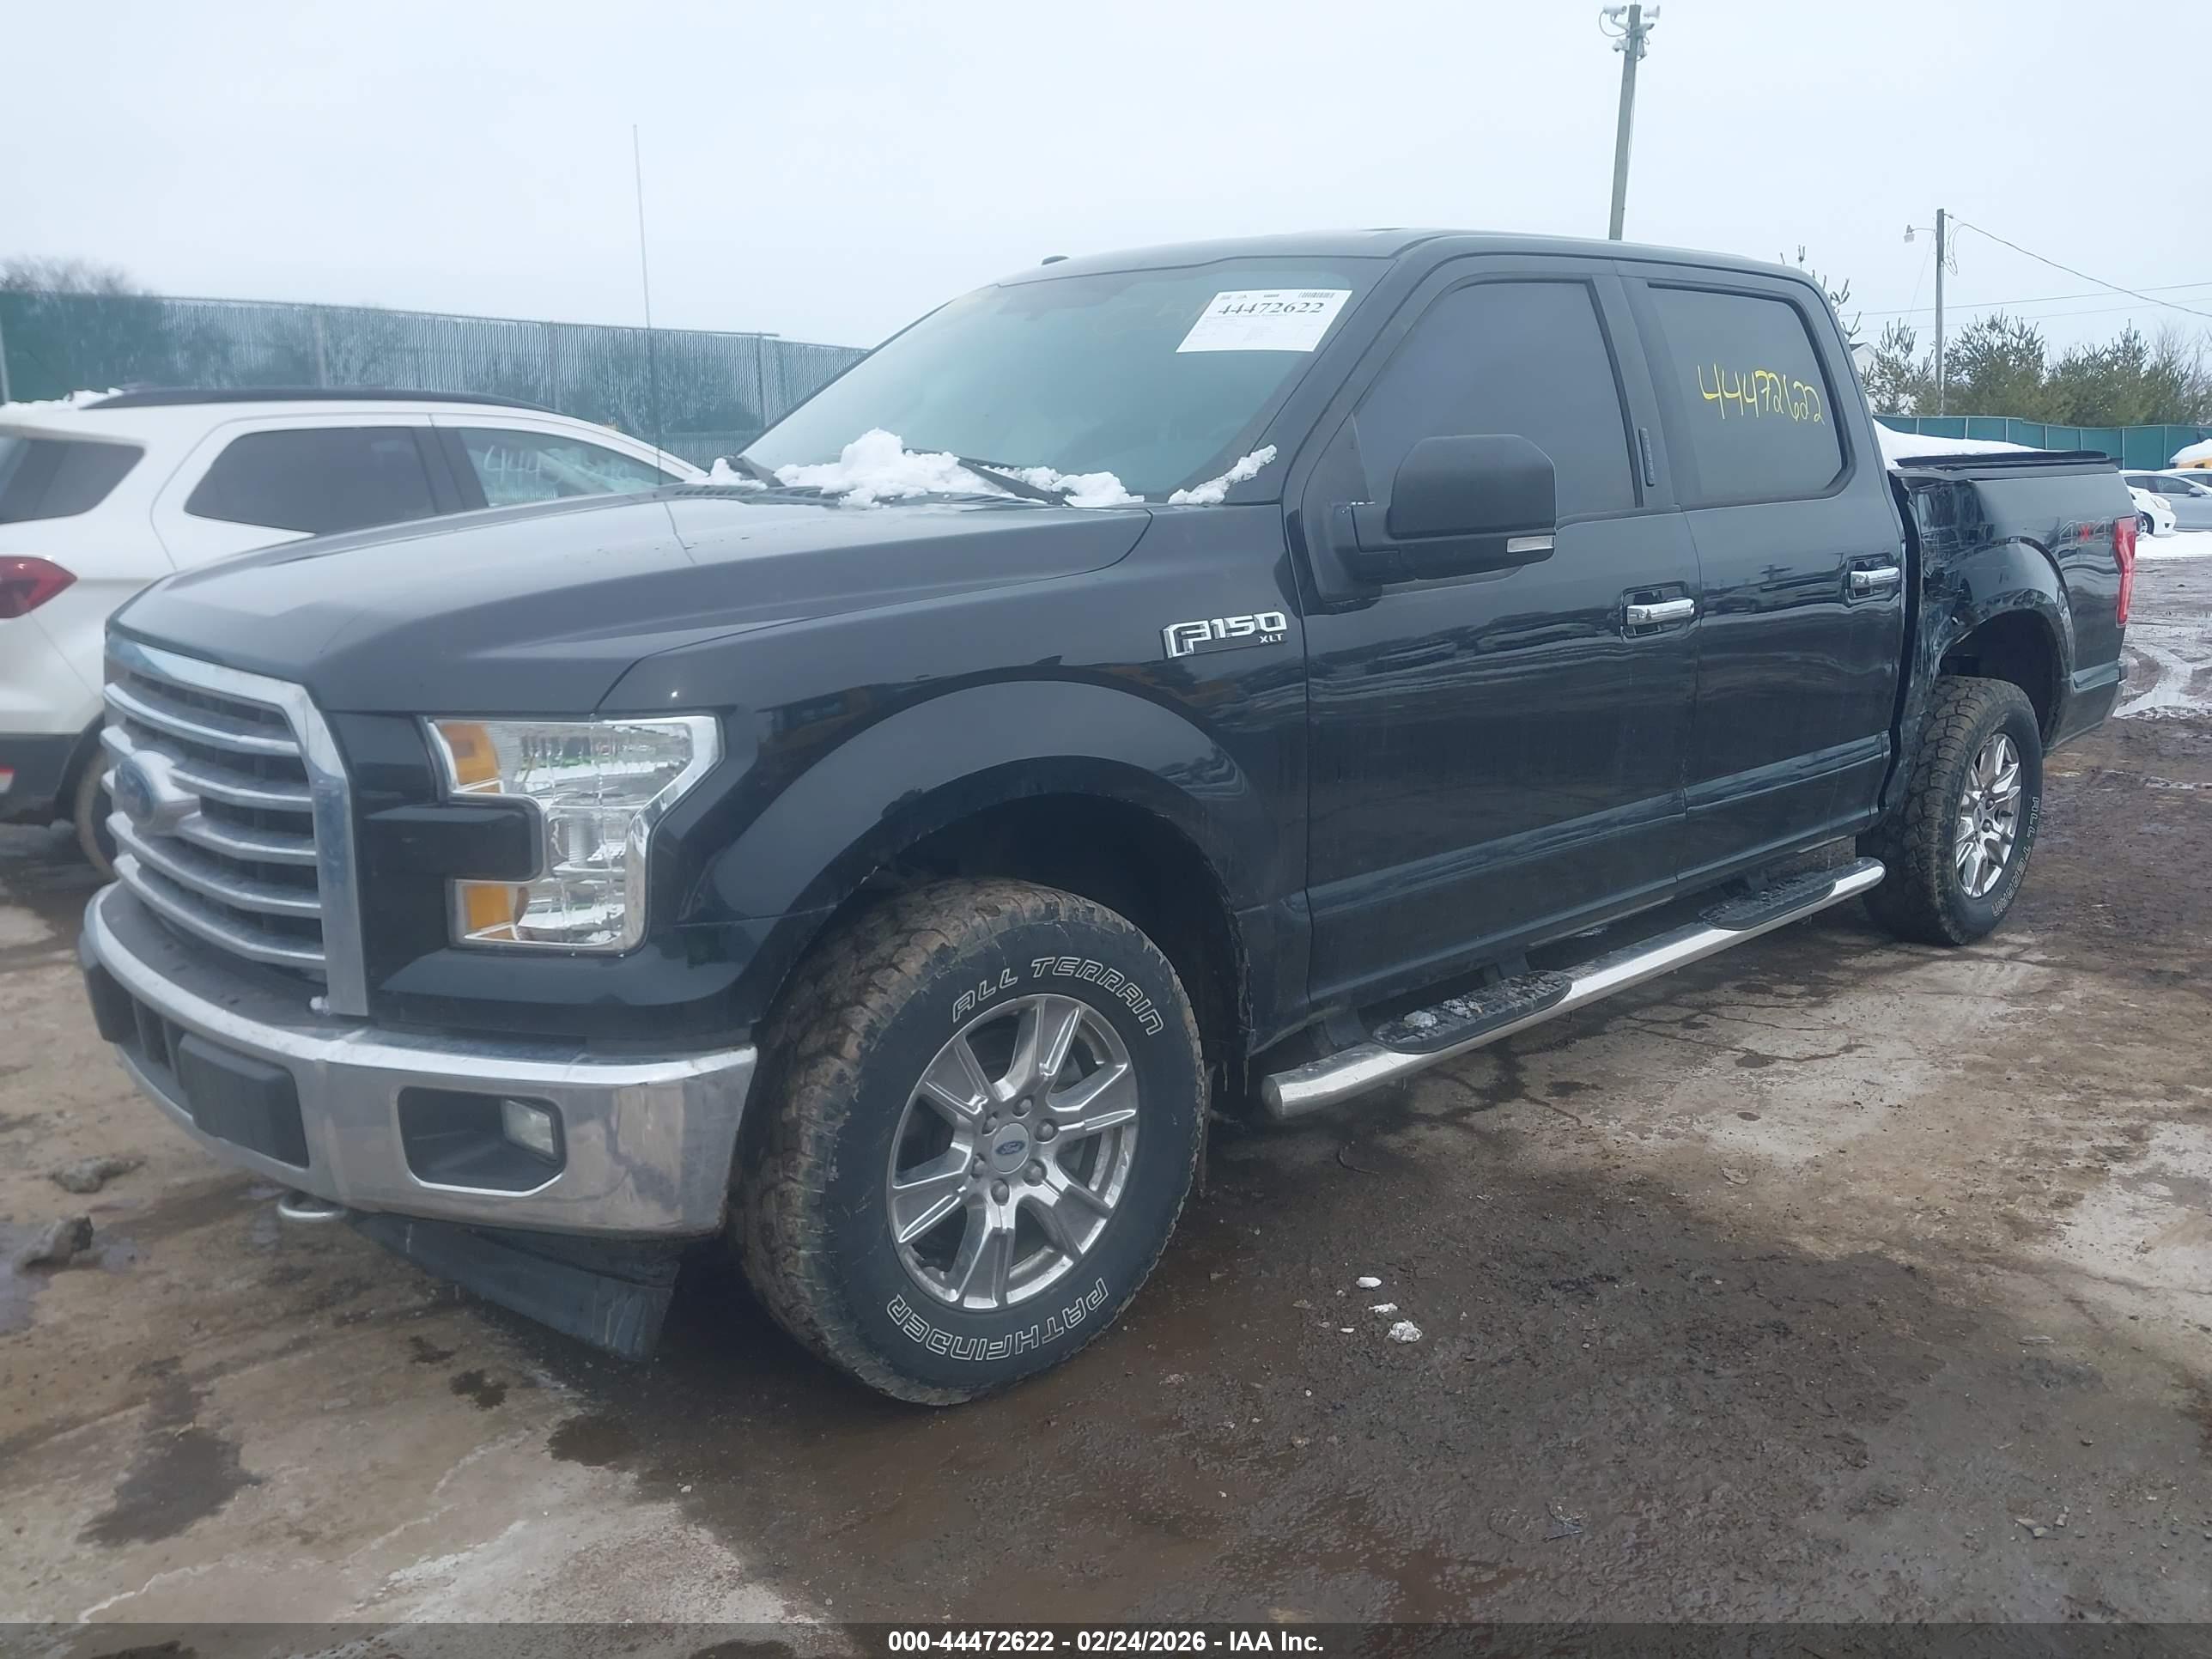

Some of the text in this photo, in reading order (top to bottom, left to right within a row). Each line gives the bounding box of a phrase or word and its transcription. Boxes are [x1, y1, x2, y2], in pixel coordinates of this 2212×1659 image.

[1218, 301, 1325, 315] 44472622
[1697, 363, 1826, 426] 44472622
[1259, 633, 1284, 643] XLT
[2026, 796, 2040, 839] ALL
[951, 956, 1165, 1037] ALL TERRAIN
[886, 1277, 1110, 1361] PATHFINDER
